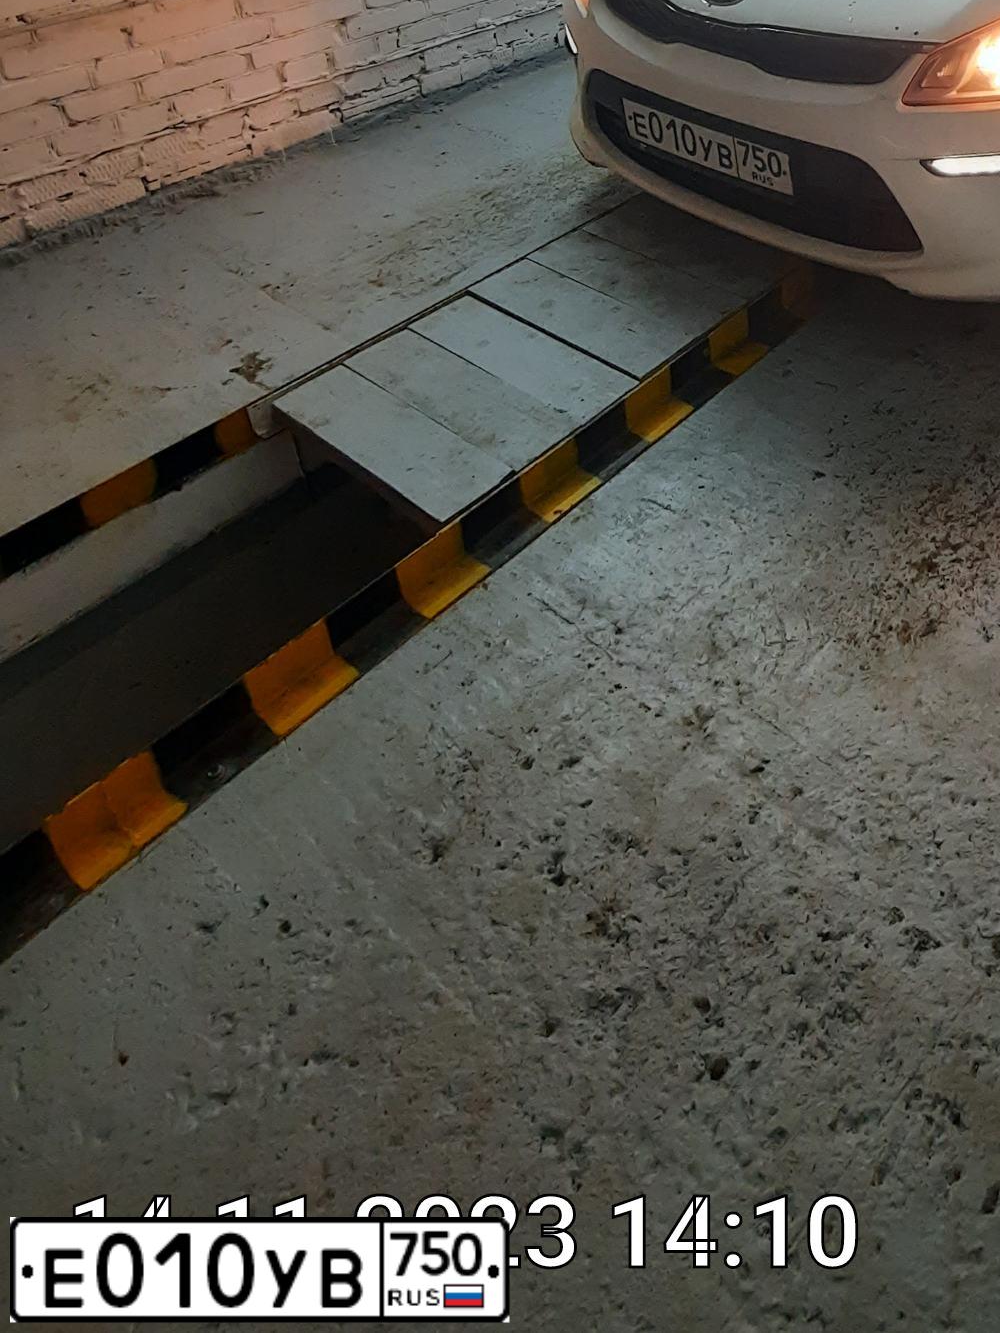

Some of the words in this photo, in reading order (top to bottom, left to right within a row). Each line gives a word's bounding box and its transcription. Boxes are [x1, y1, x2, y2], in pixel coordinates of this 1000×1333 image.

[633, 112, 734, 170] Е010УВ
[737, 140, 782, 178] 750
[752, 171, 774, 187] RUS
